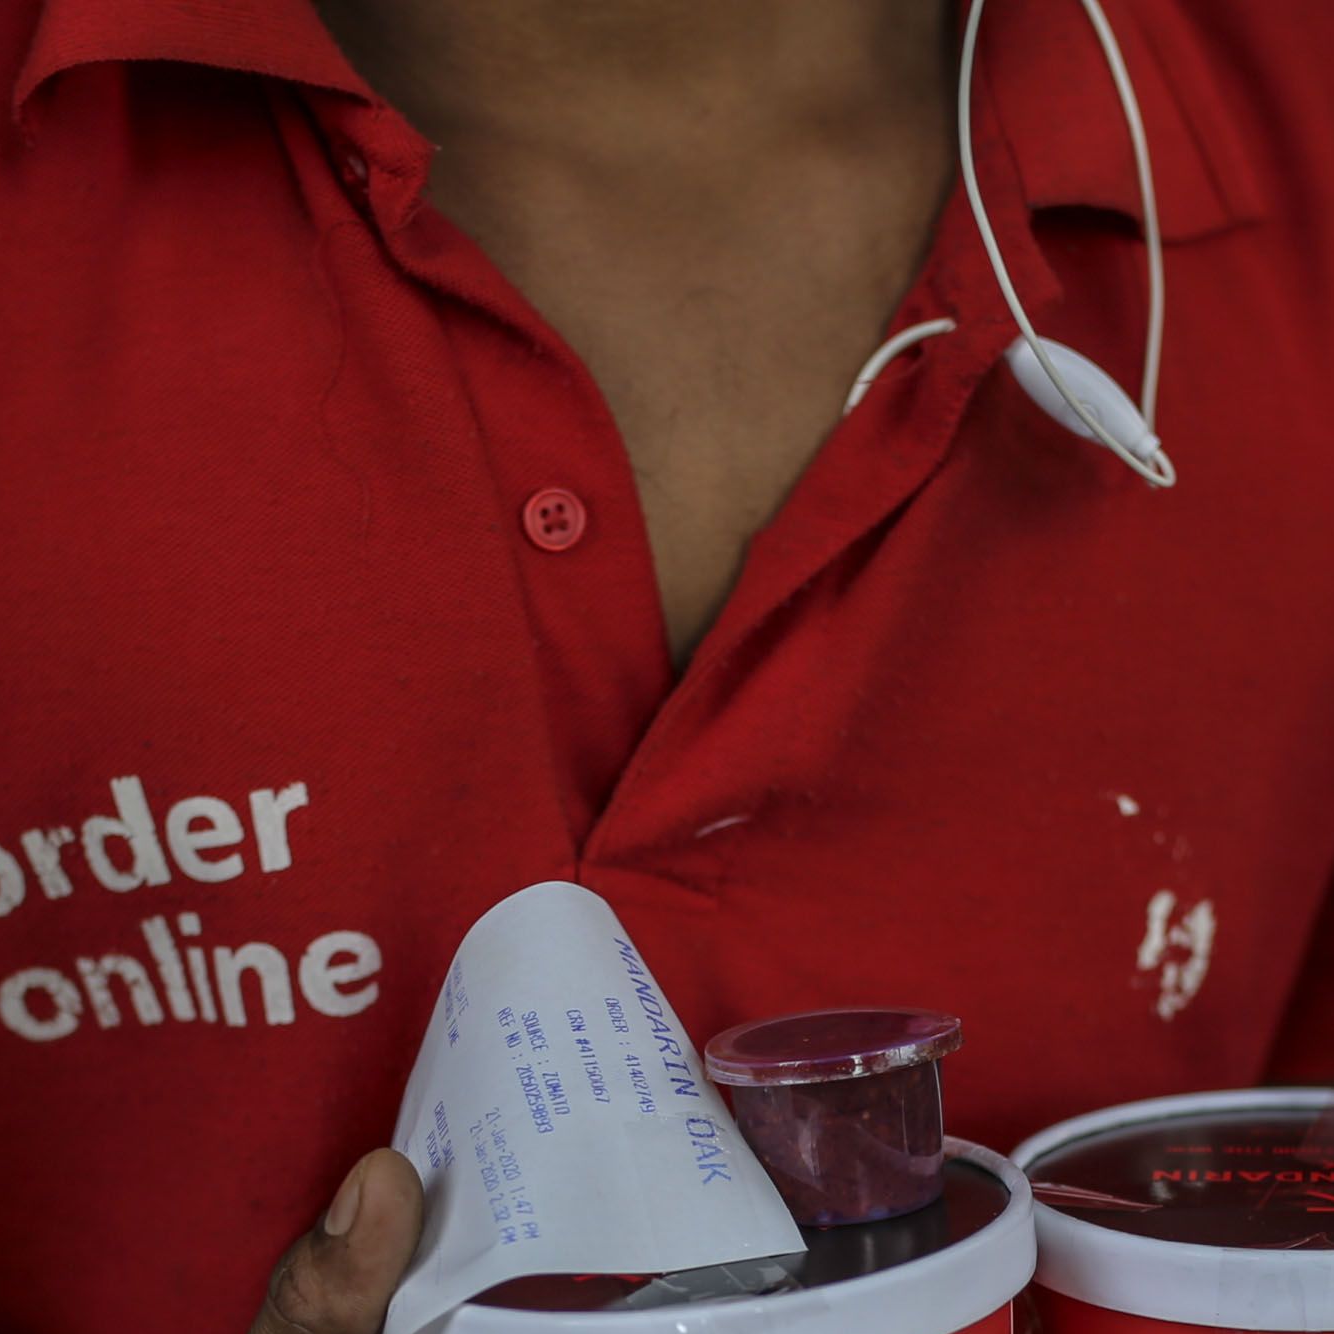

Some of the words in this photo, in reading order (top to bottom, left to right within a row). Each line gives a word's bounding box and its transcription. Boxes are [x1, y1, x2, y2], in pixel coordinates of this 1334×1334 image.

[497, 1006, 516, 1028] REF
[522, 1010, 549, 1053] SOURCE
[542, 1071, 570, 1115] ZOMATO
[566, 1009, 586, 1033] CRN
[605, 997, 630, 1034] ORDER
[624, 1054, 656, 1113] 41402749
[614, 937, 700, 1098] MANDARIN
[685, 1117, 732, 1185] OAK
[485, 1106, 522, 1181] 21-Jan-2020
[521, 1221, 540, 1239] PM
